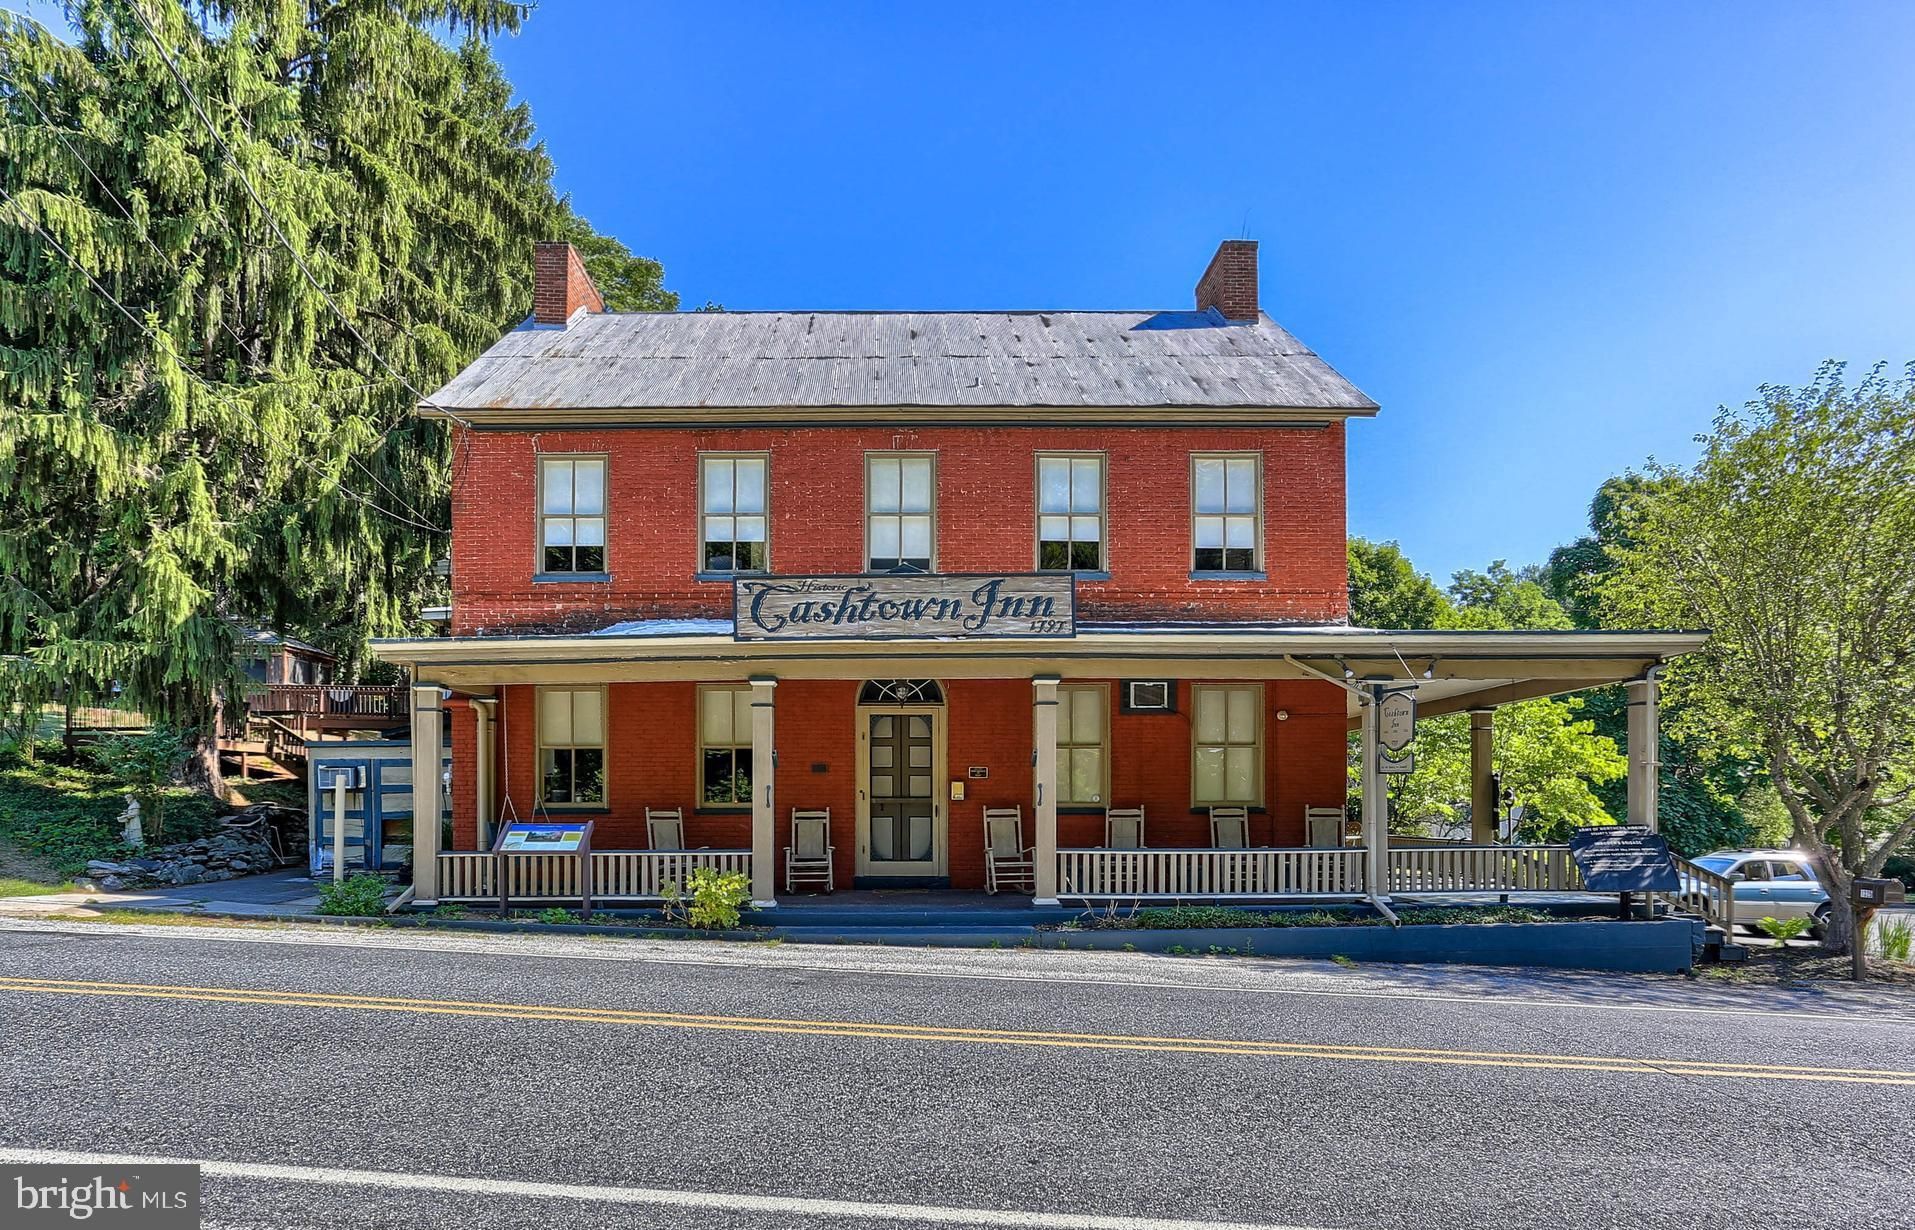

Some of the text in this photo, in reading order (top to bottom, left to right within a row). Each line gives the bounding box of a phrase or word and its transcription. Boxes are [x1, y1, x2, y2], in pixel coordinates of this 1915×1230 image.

[798, 580, 848, 593] Historic
[743, 578, 1056, 633] Cashtown Inn
[1030, 619, 1067, 633] 1797
